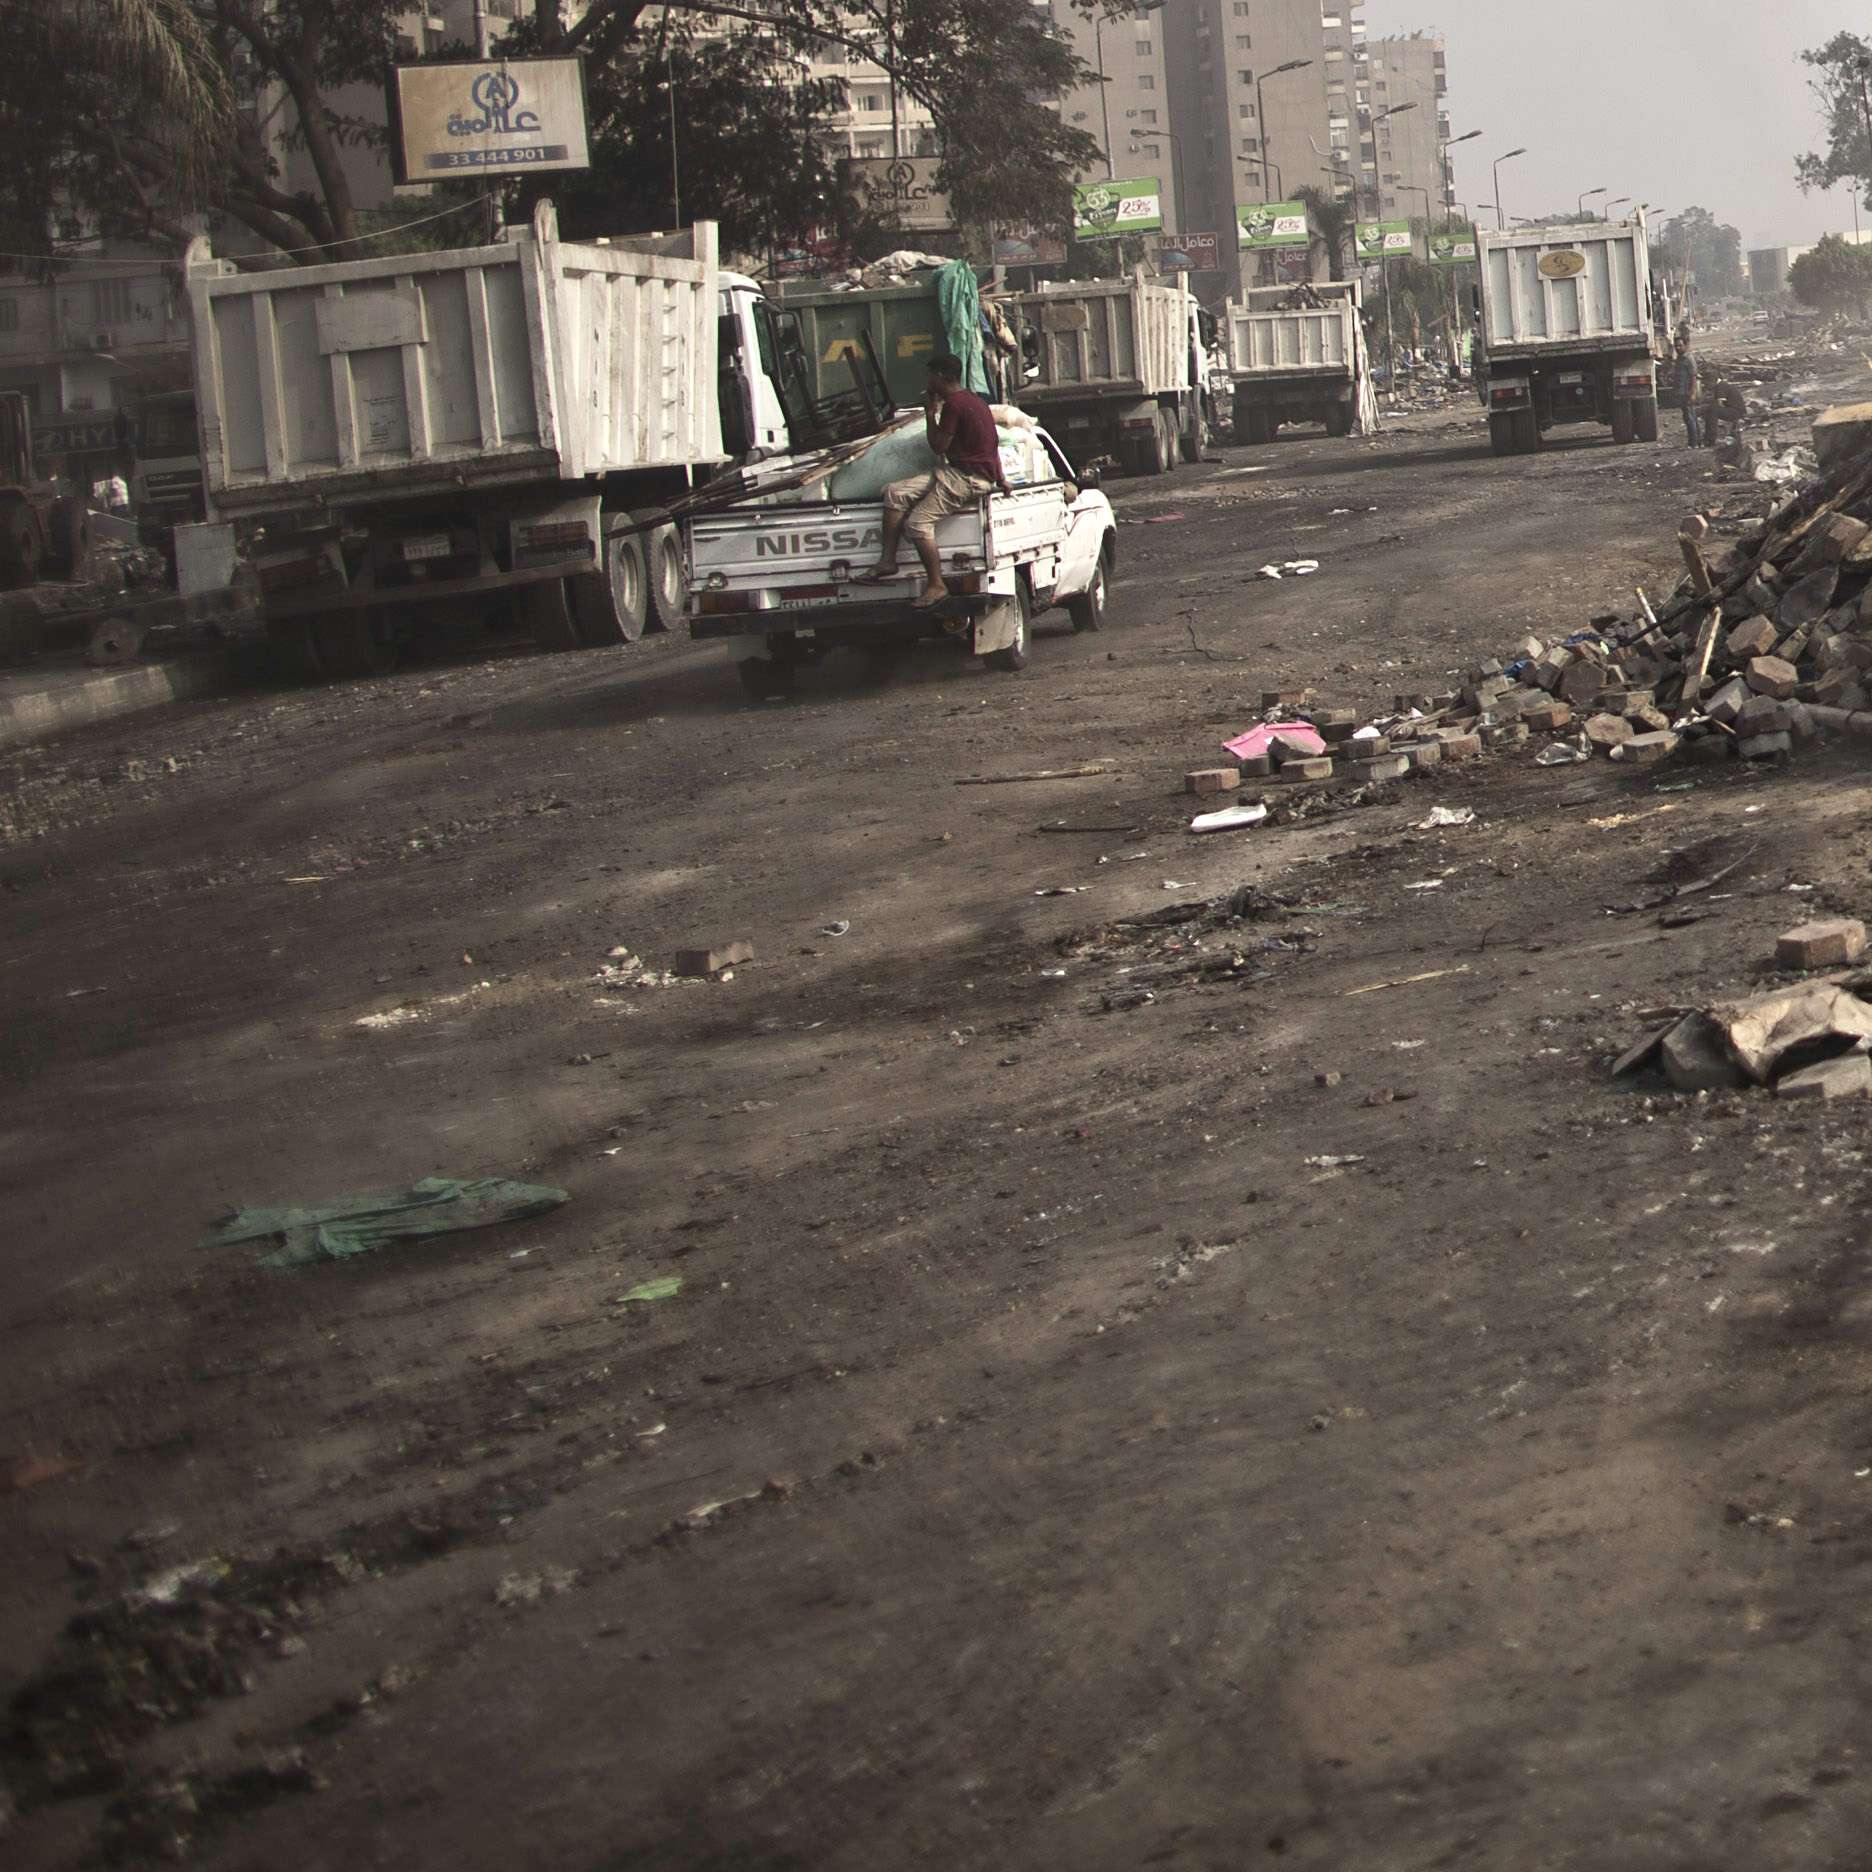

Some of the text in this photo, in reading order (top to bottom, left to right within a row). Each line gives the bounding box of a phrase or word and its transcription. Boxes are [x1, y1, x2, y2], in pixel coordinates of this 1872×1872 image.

[448, 148, 545, 166] 33 444 901
[1180, 236, 1215, 251] معامل
[756, 528, 882, 557] NISSA
